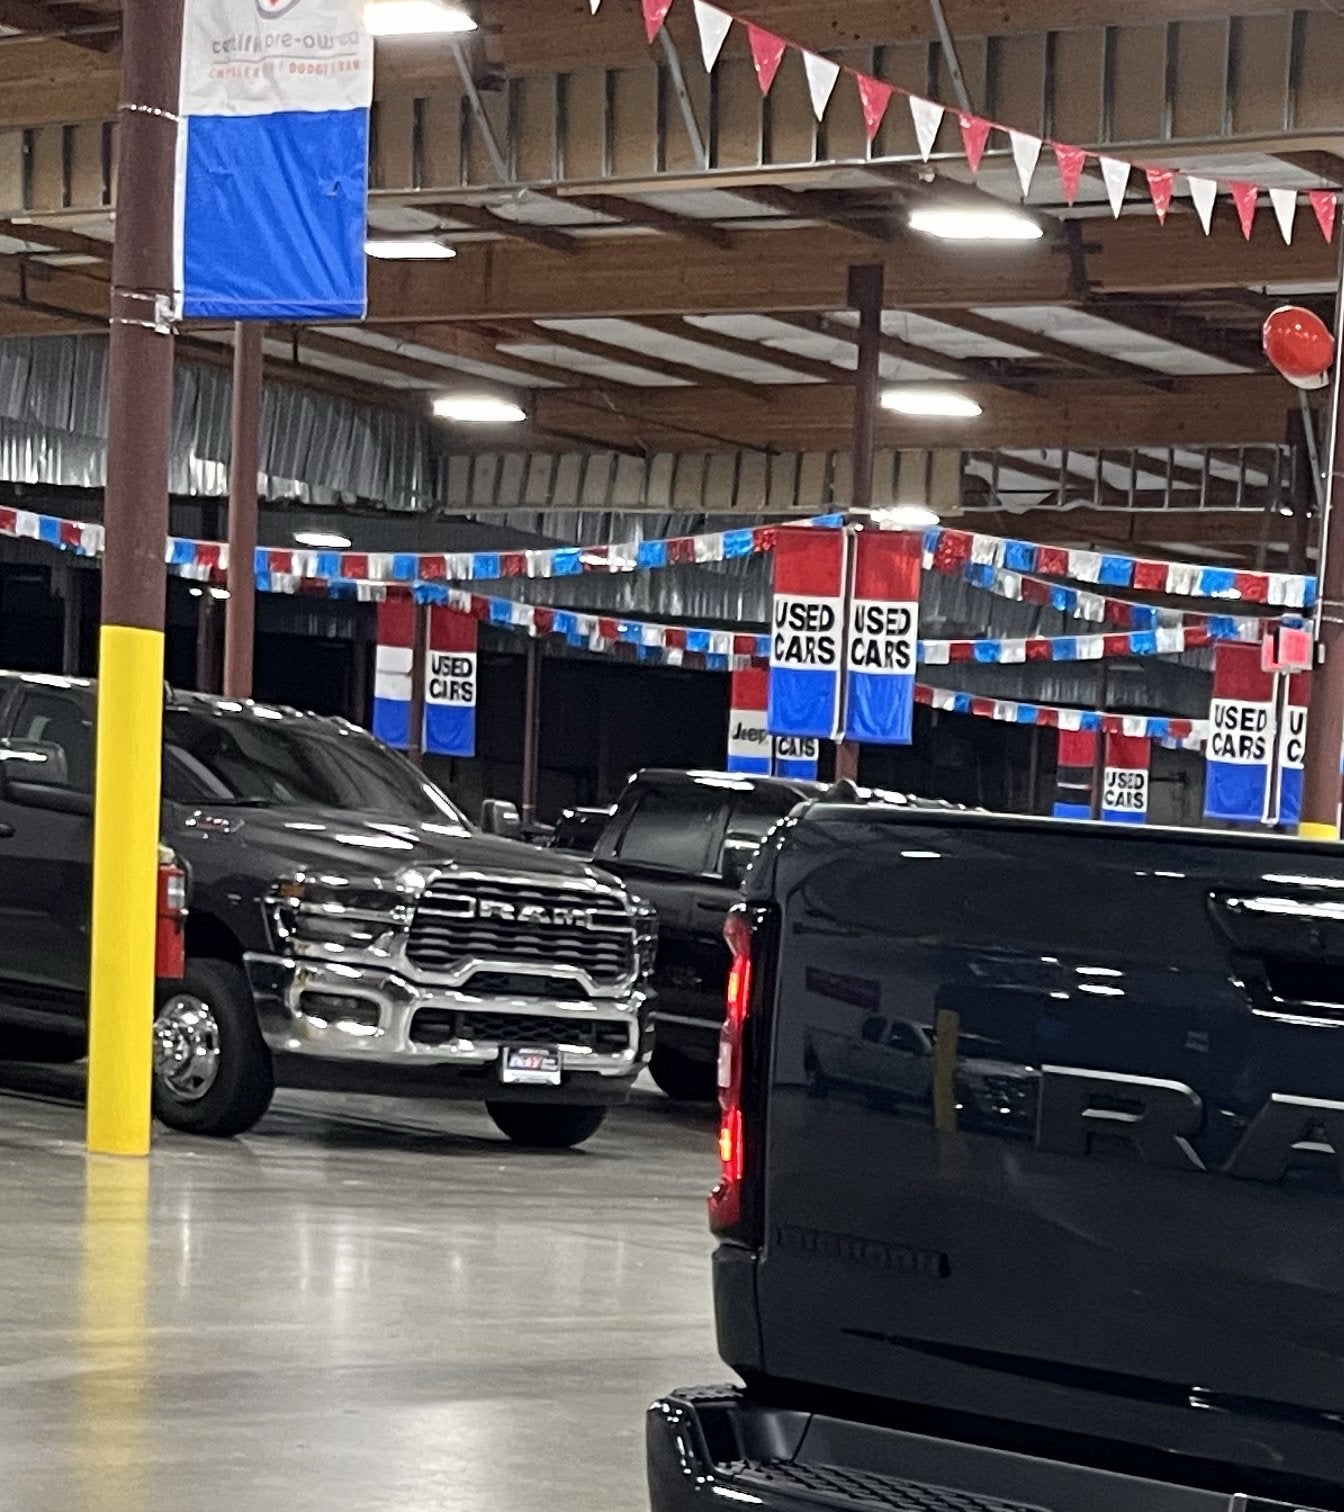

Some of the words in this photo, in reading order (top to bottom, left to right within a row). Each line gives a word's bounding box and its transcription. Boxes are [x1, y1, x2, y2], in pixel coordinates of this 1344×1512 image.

[775, 602, 835, 632] USED
[855, 605, 911, 636] USED
[774, 633, 835, 664] CARS
[851, 638, 911, 668] CARS
[431, 654, 472, 678] USED
[1214, 704, 1267, 732] USED
[1212, 733, 1265, 759] CARS
[480, 900, 592, 927] RAM
